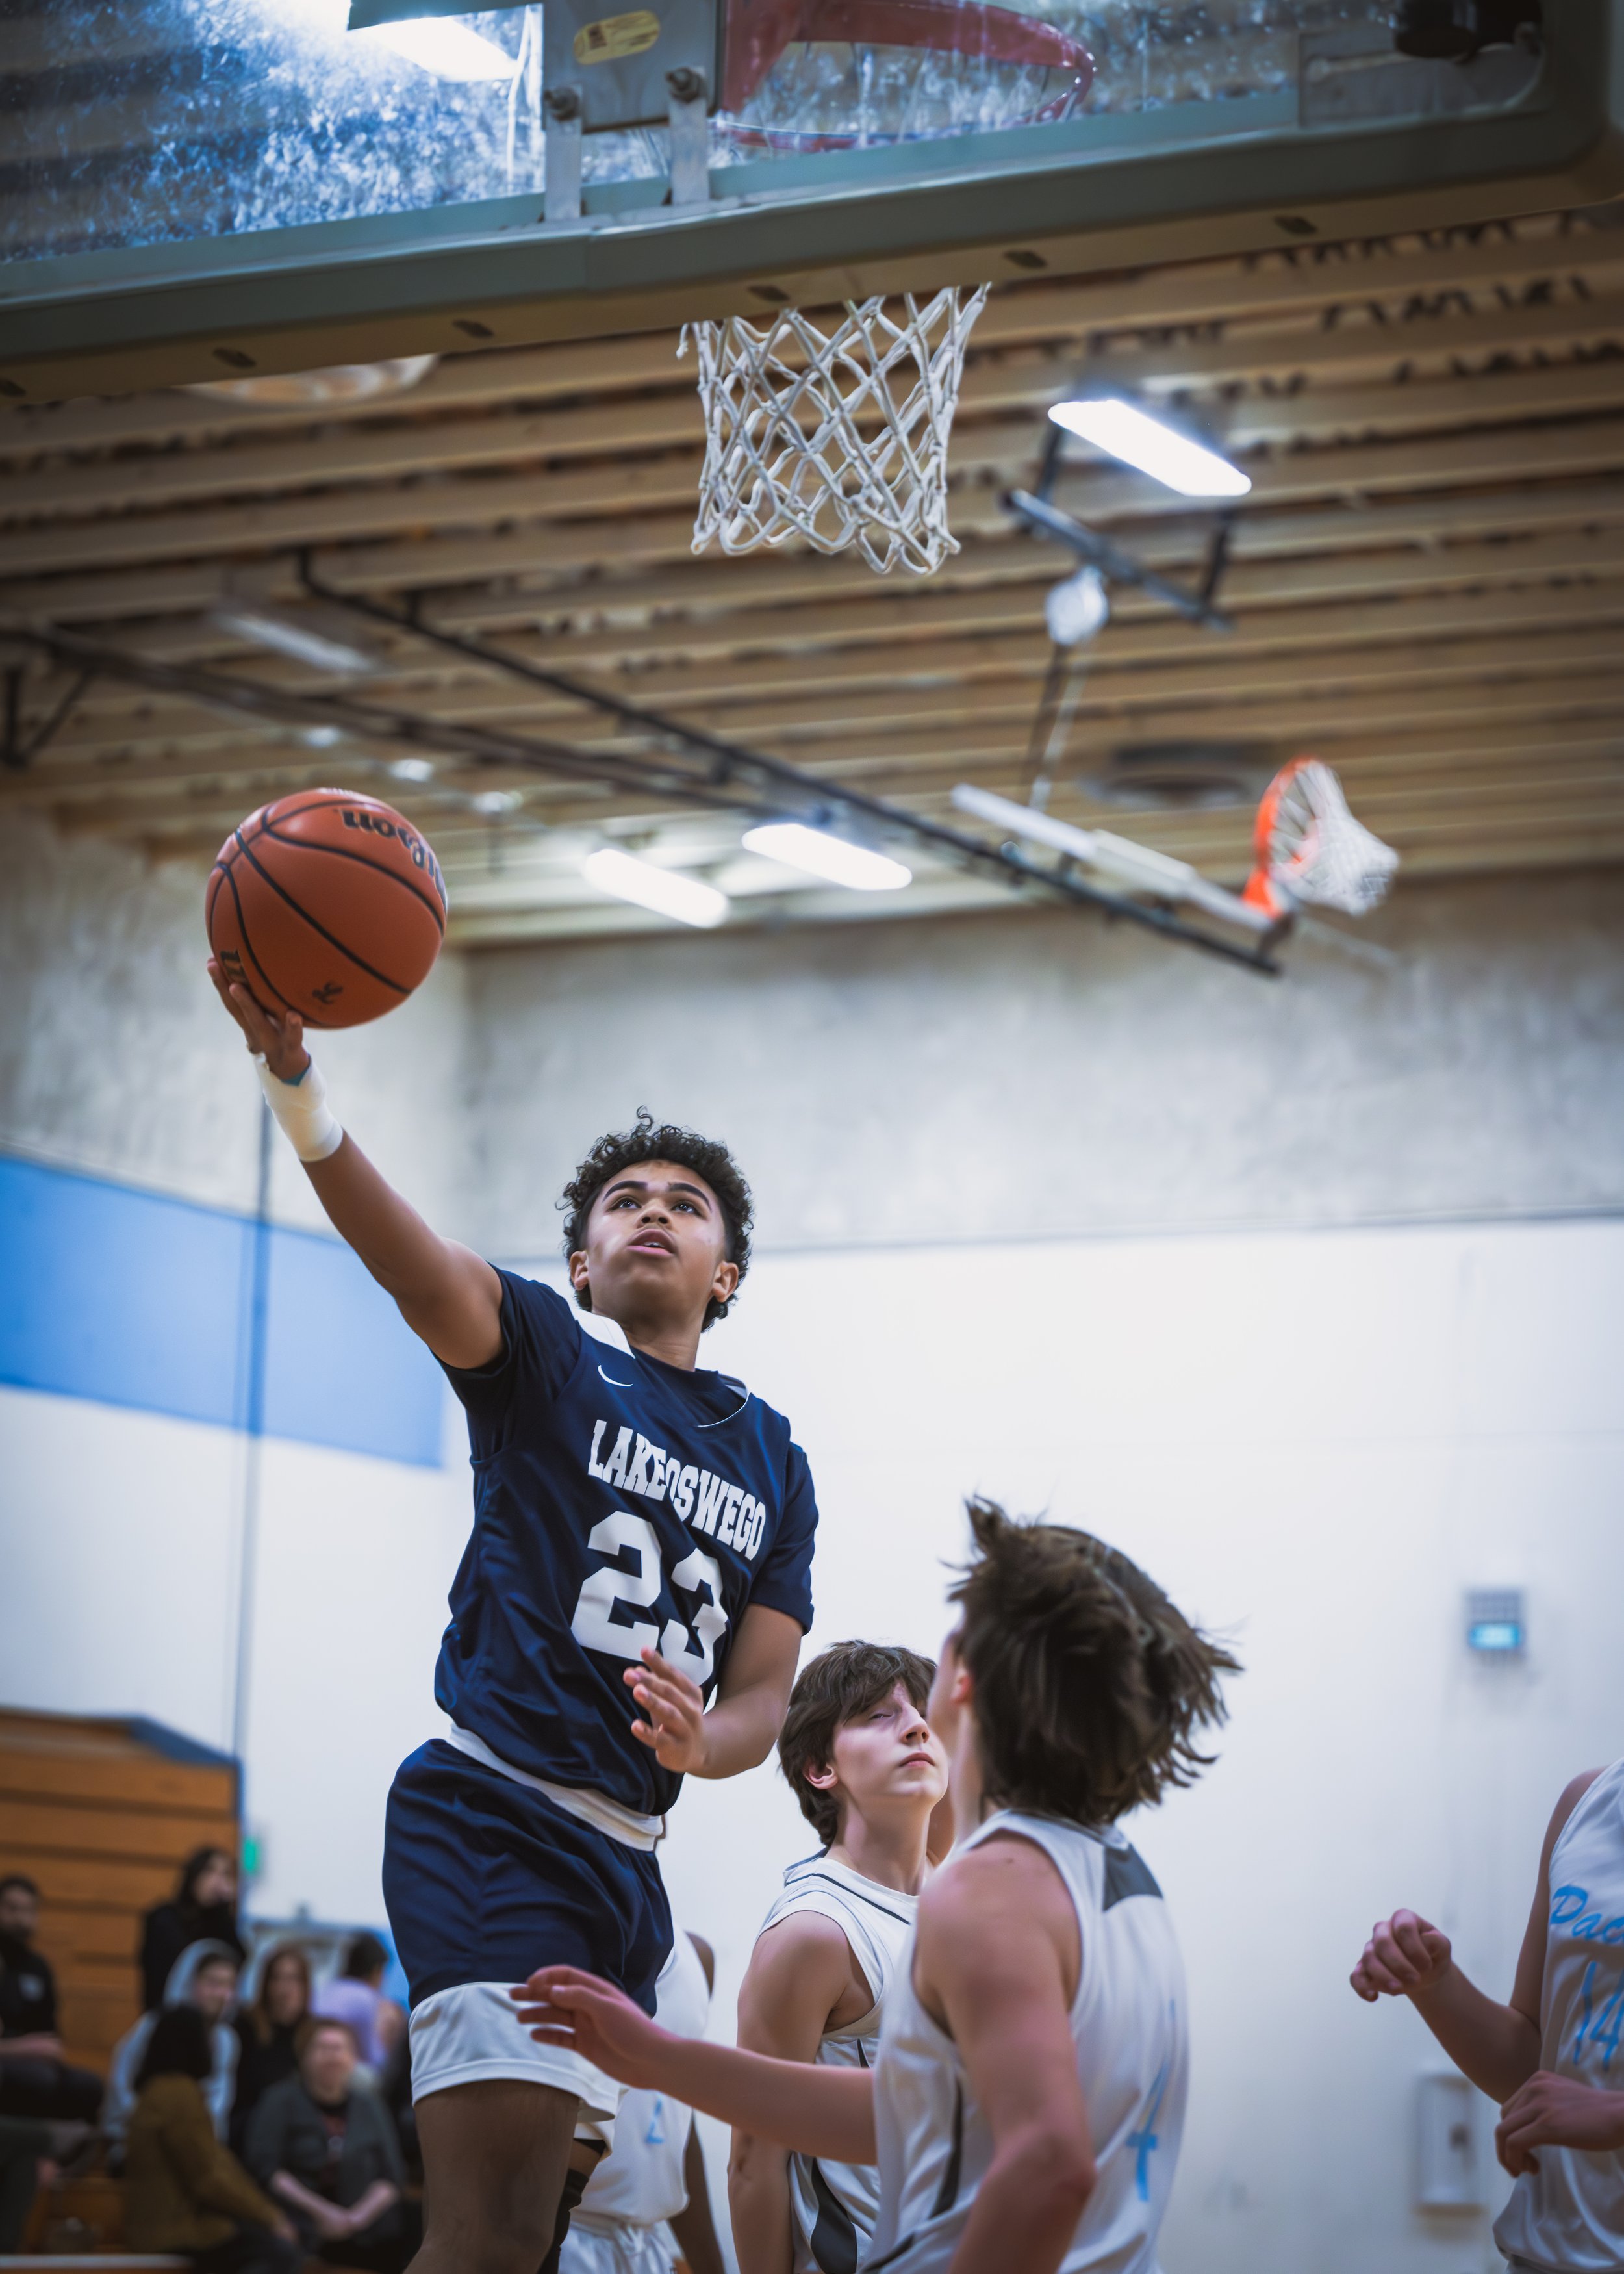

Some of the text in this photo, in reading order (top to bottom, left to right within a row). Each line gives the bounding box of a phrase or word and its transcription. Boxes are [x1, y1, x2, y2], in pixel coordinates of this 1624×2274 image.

[588, 1419, 767, 1561] LAKE OSWEGO
[570, 1510, 728, 1687] 23
[1573, 1961, 1624, 2072] 14
